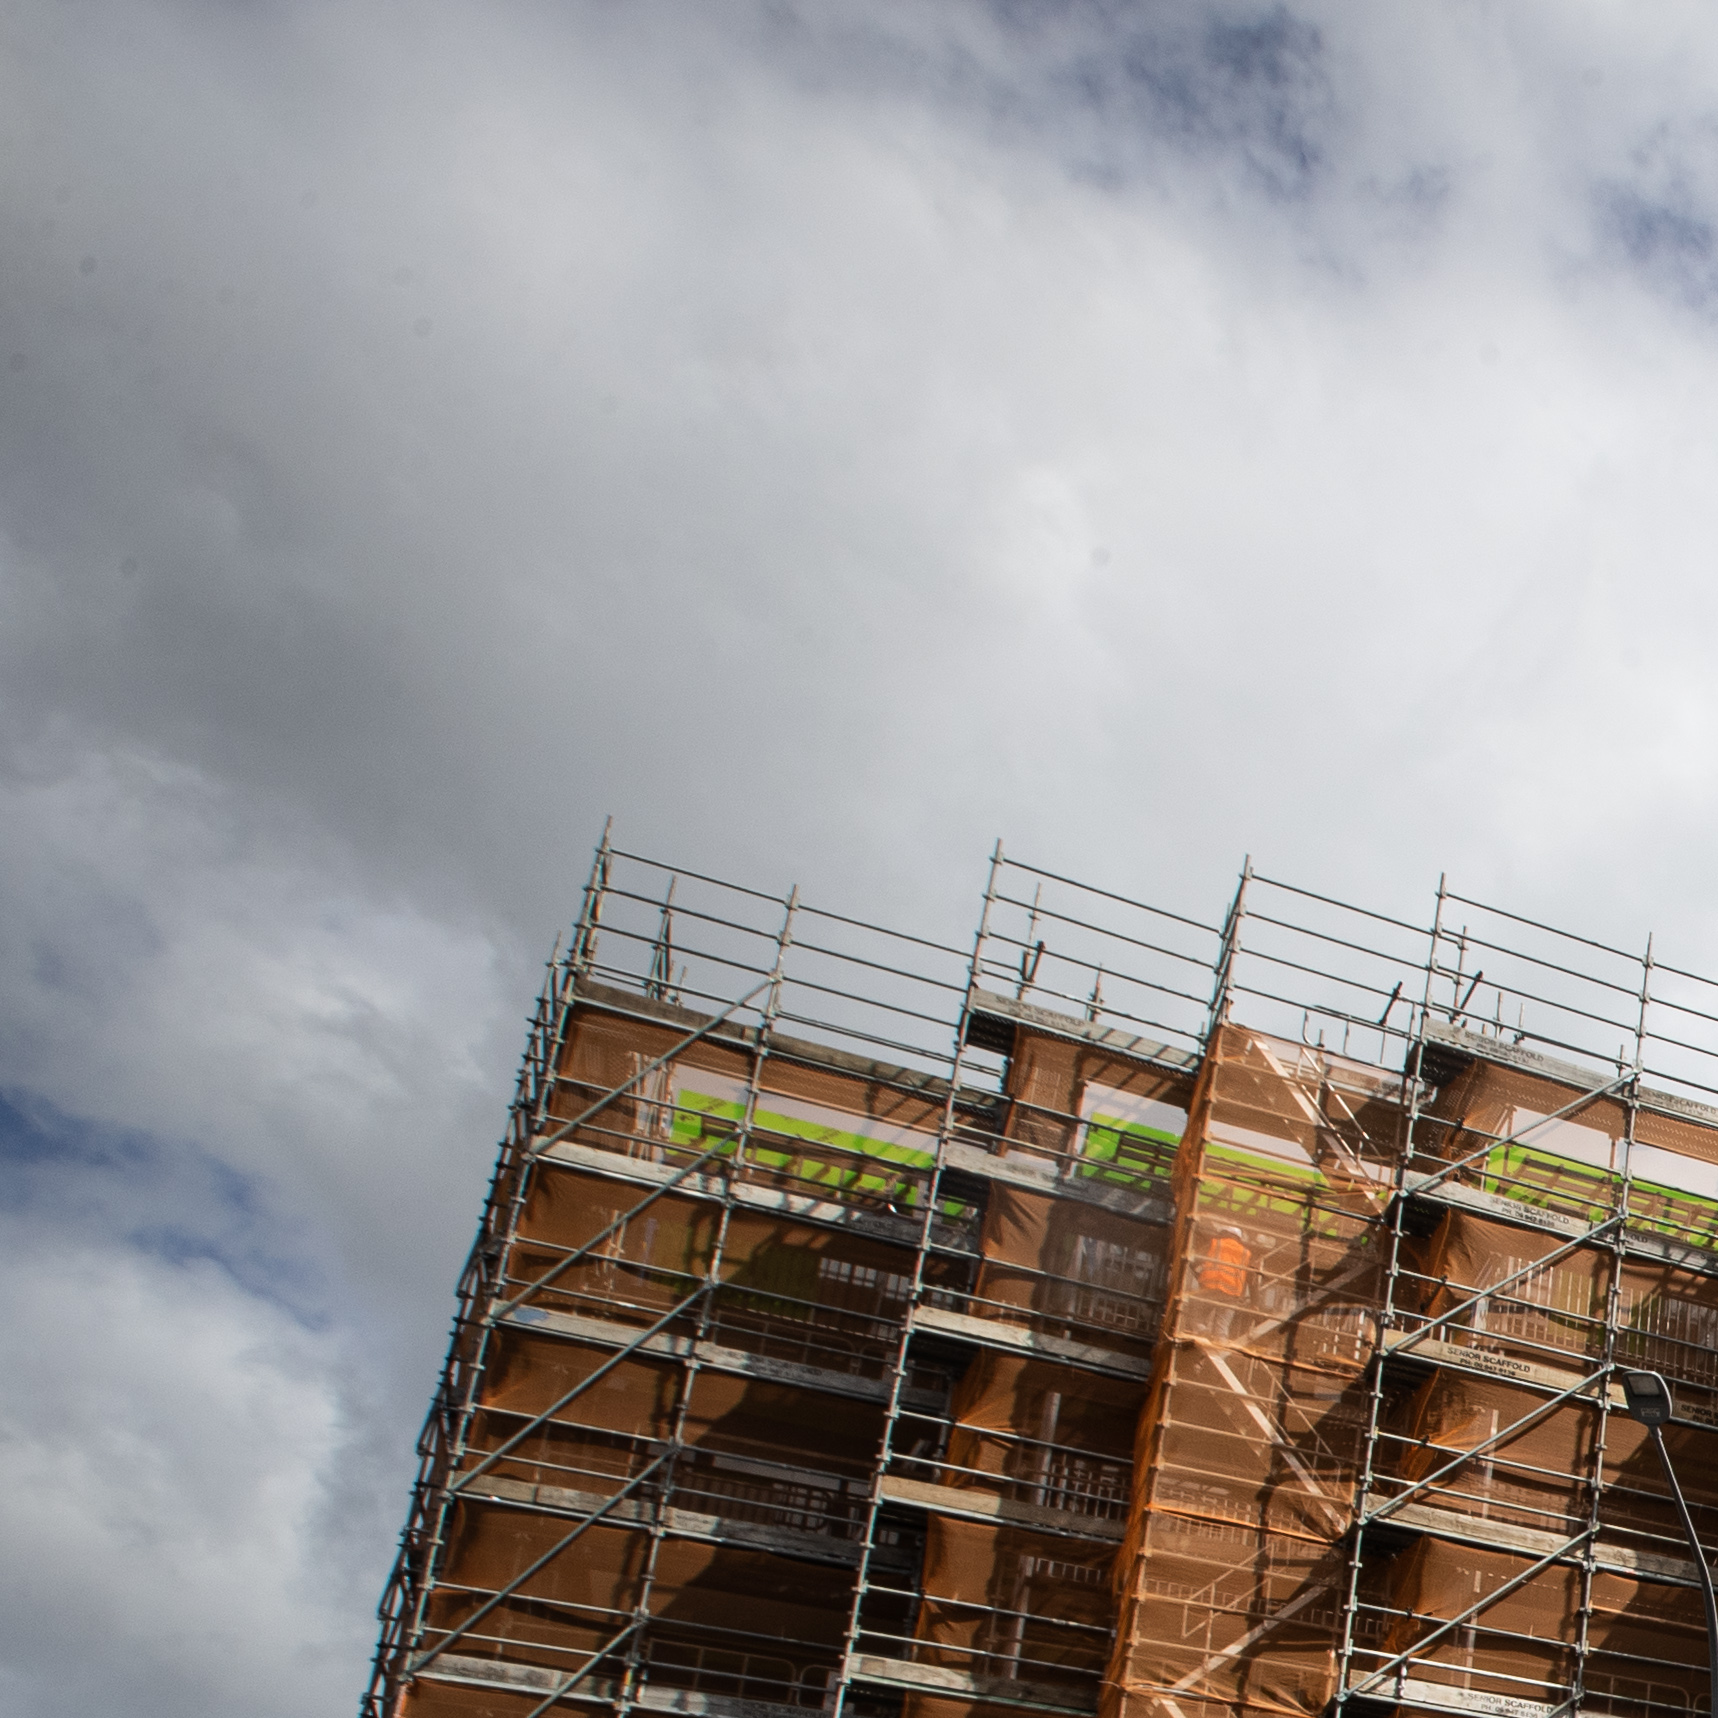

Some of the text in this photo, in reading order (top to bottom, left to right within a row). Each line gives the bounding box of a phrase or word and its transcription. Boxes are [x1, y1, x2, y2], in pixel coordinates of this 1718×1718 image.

[1524, 1206, 1569, 1224] SCAFFOLD
[1447, 1347, 1530, 1372] SENIOR SCAFFOLD
[1681, 1404, 1712, 1417] SENIOR
[1468, 1692, 1553, 1714] SENIOR SCAFFOLD
